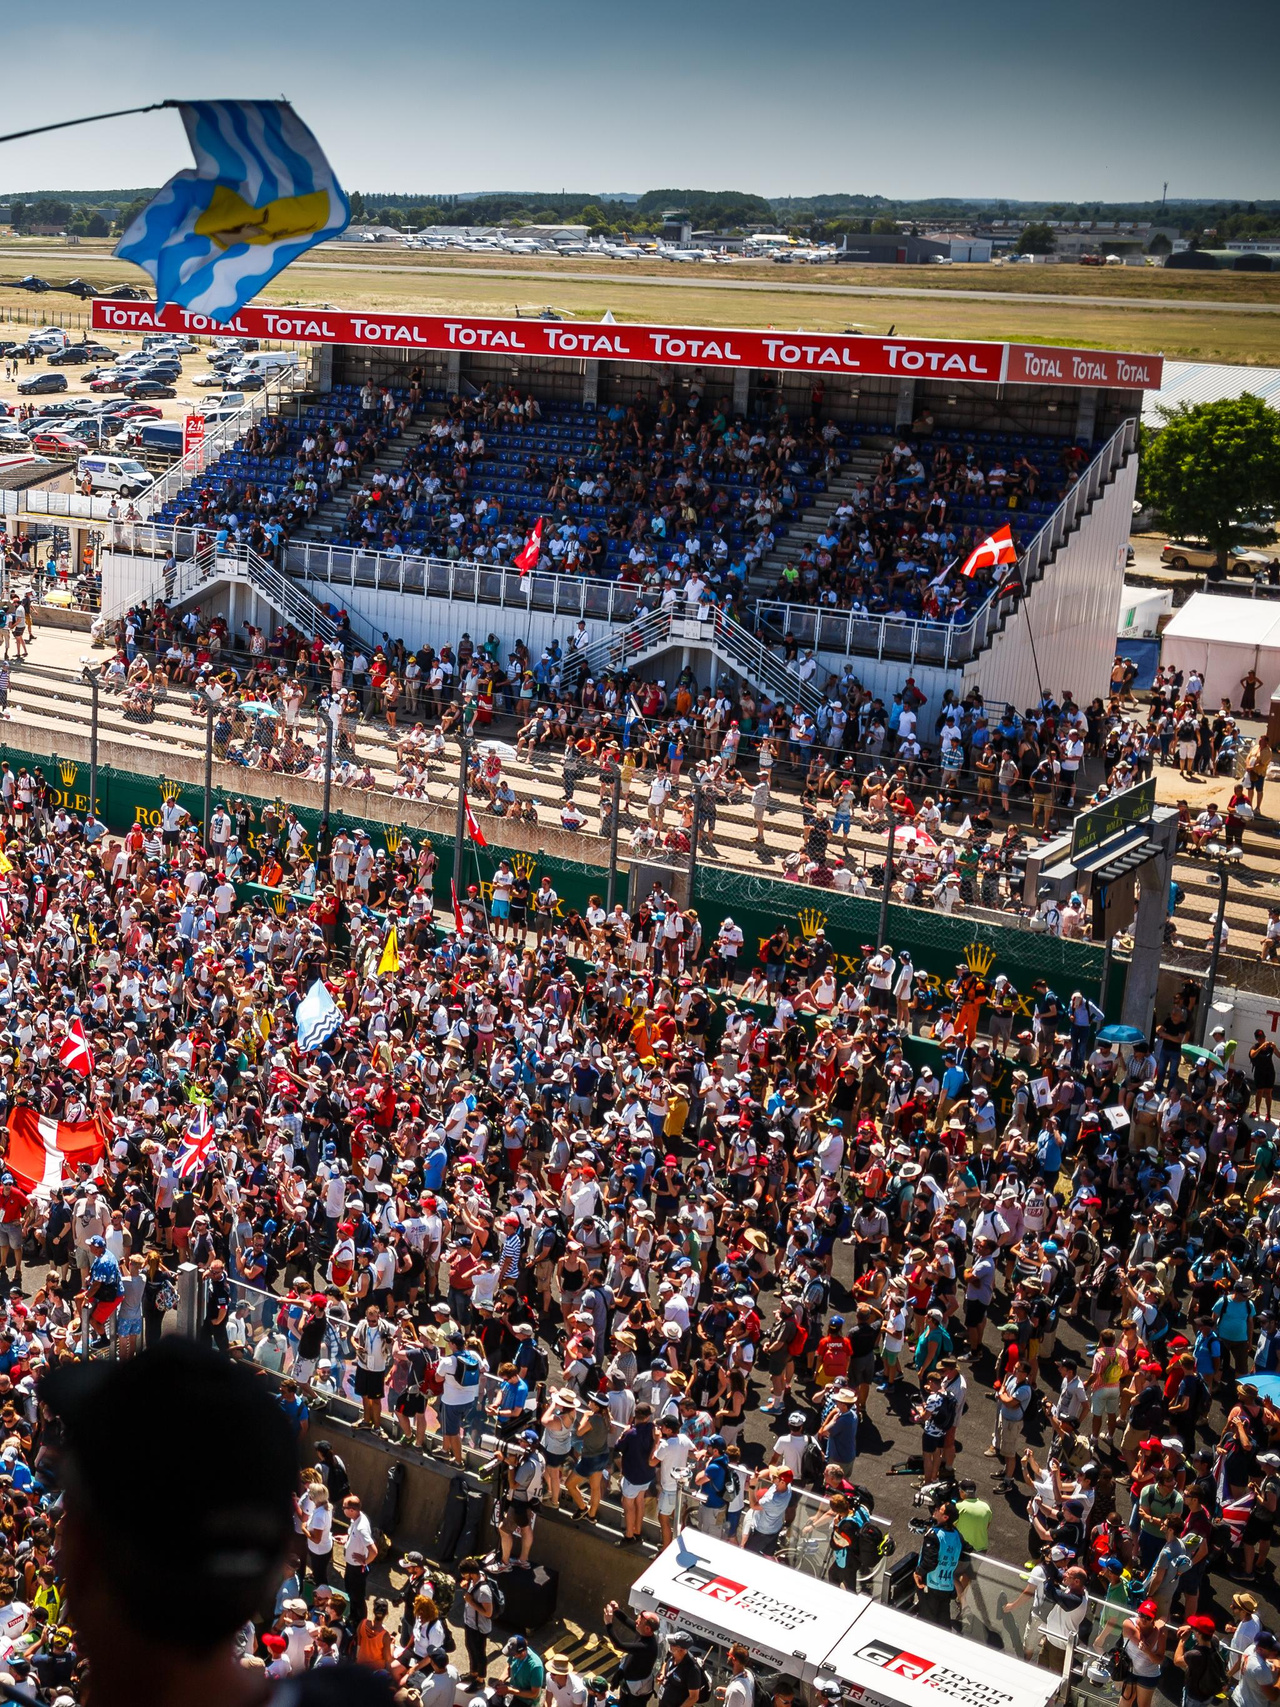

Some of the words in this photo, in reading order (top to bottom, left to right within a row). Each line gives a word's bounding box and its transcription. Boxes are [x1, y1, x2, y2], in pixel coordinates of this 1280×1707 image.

[100, 306, 166, 328] TOTAL
[262, 314, 336, 338] TOTAL
[350, 319, 427, 343] TOTAL
[443, 323, 526, 349] TOTAL
[543, 328, 630, 354] TOTAL
[649, 333, 741, 360] TOTAL
[761, 339, 861, 367] TOTAL
[883, 345, 988, 374] TOTAL
[1024, 352, 1063, 378] TOTAL
[1072, 356, 1108, 381] TOTAL
[1116, 359, 1150, 383] TOTAL
[50, 789, 101, 815] OLEX
[673, 1570, 742, 1602] GR
[656, 1605, 678, 1621] GR
[734, 1601, 796, 1631] Racing
[742, 1596, 805, 1624] GAZOO
[752, 1589, 818, 1621] TOYOTA
[8, 1615, 24, 1628] TOTAL
[679, 1616, 715, 1637] TOYOTA
[716, 1632, 750, 1651] GAZOO
[751, 1647, 784, 1667] Racing
[856, 1645, 926, 1680] GR
[929, 1673, 1000, 1705] GAZOO
[940, 1666, 1014, 1702] TOYOTA
